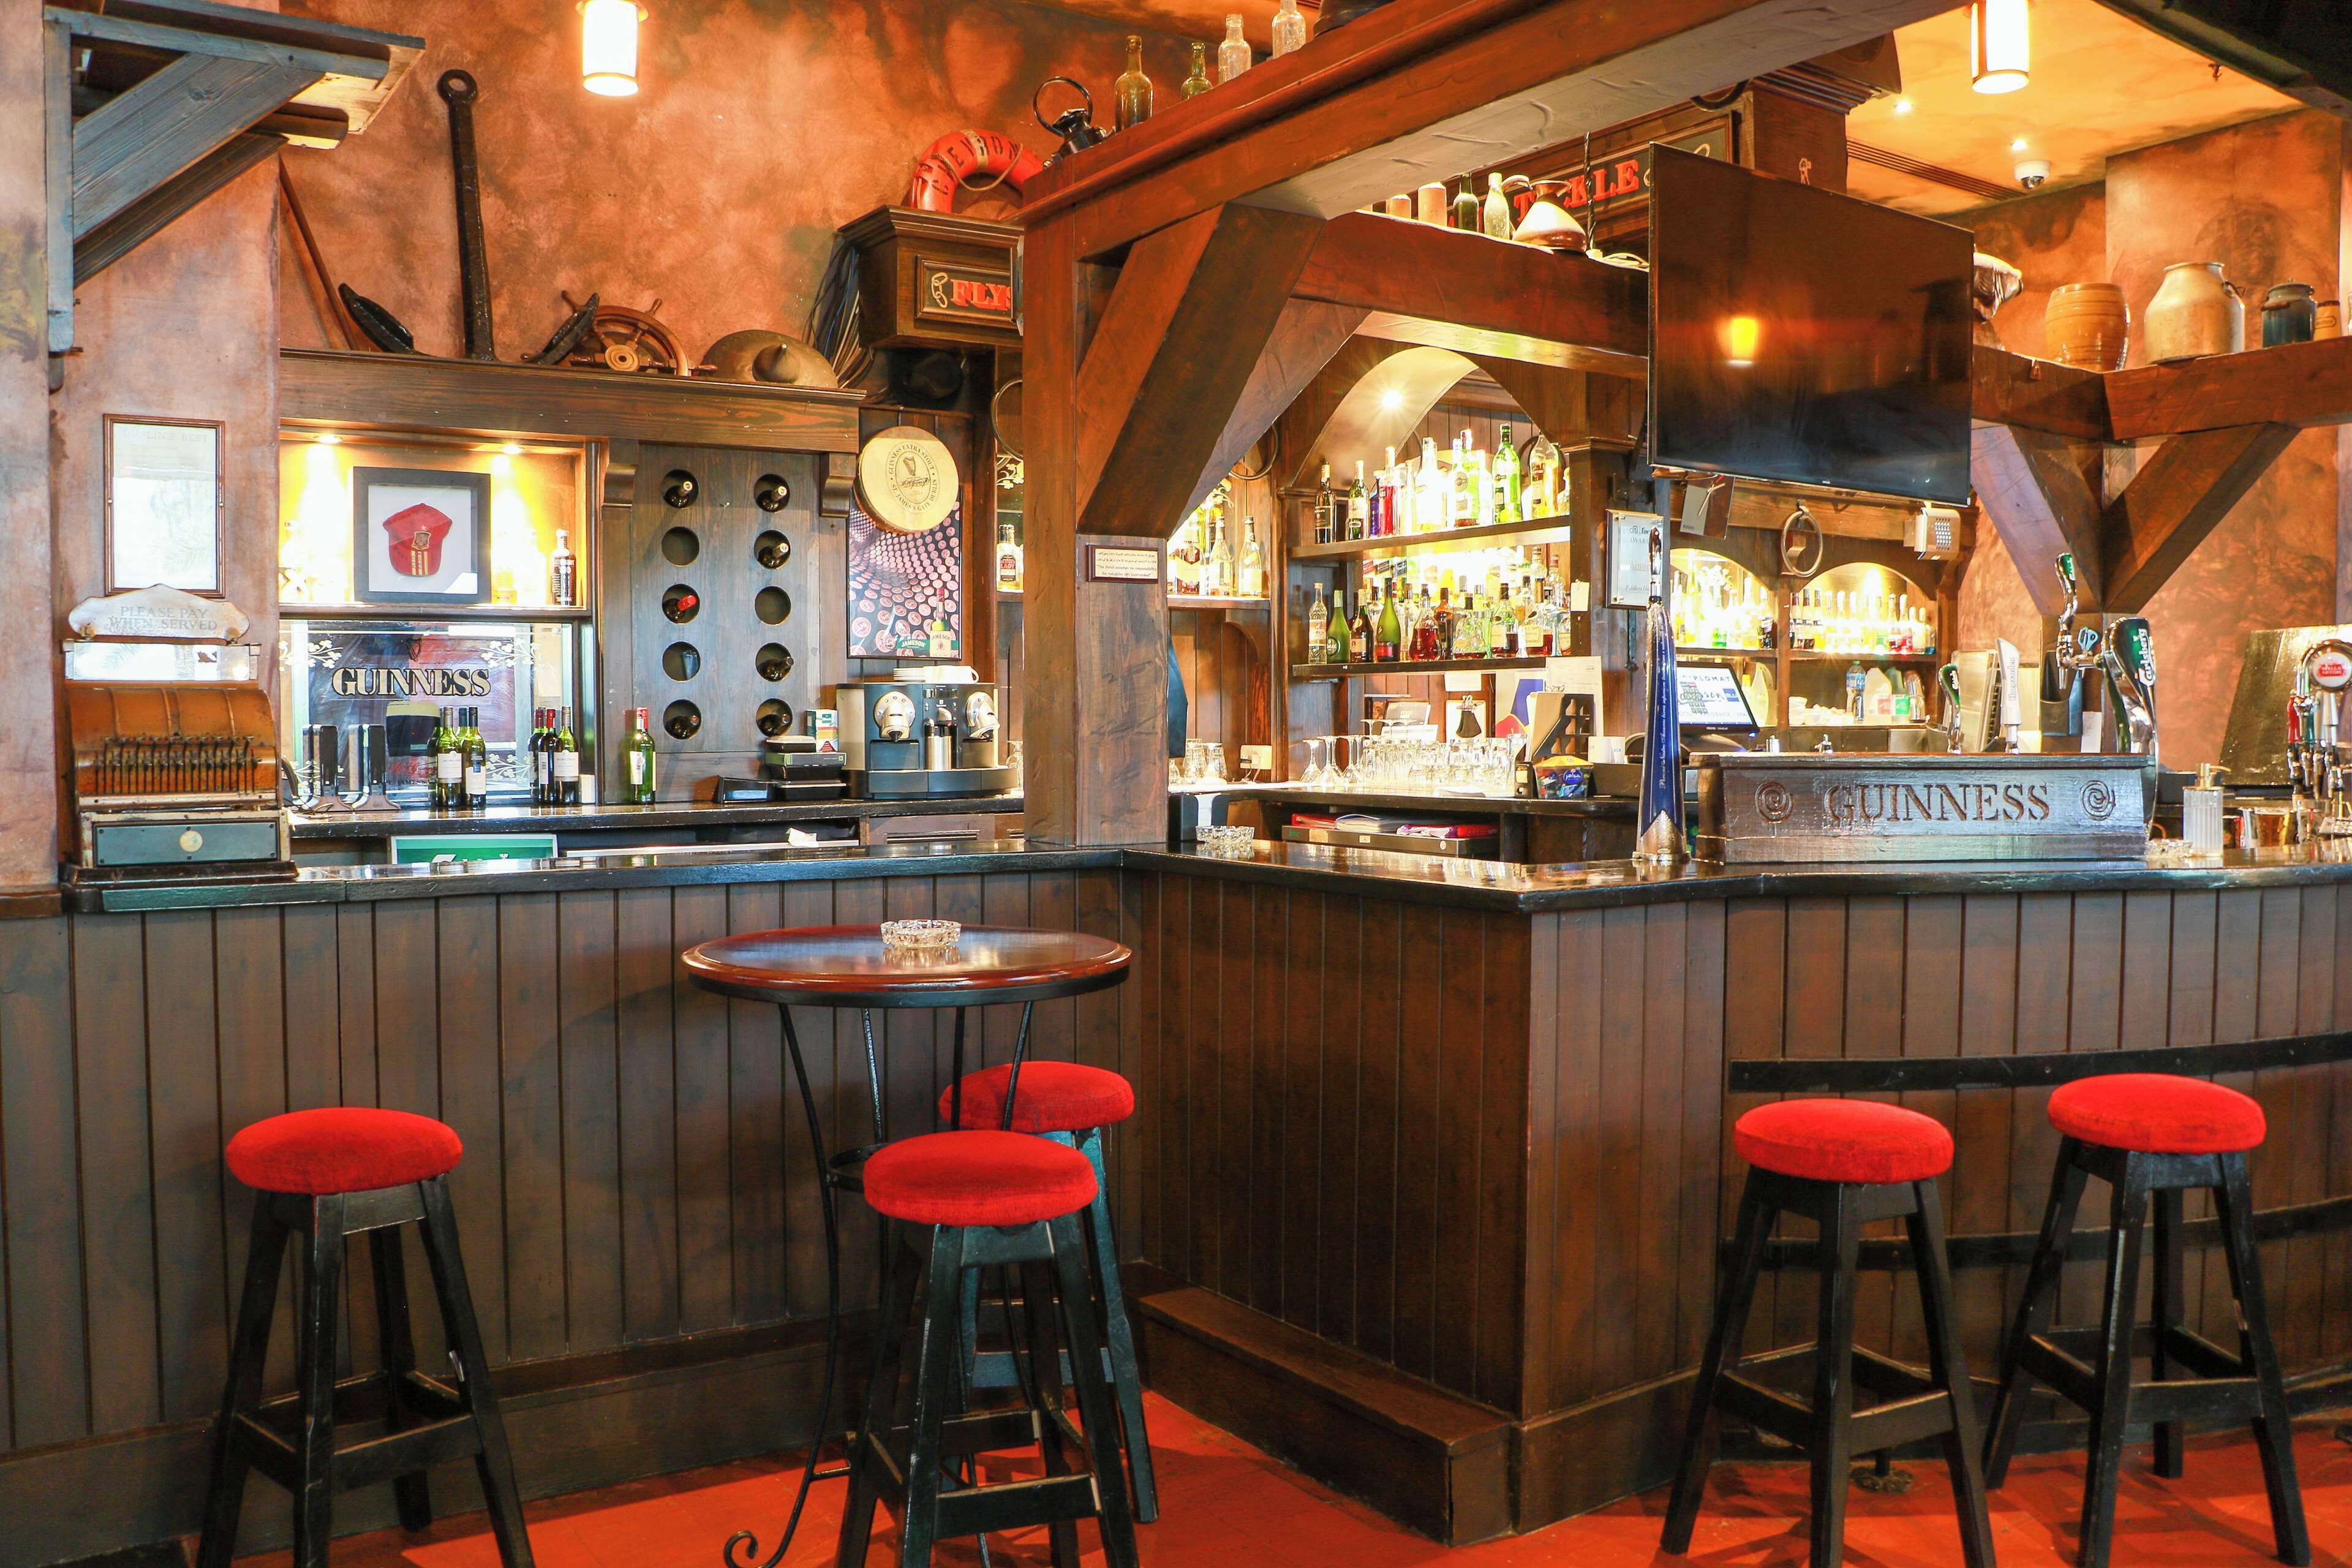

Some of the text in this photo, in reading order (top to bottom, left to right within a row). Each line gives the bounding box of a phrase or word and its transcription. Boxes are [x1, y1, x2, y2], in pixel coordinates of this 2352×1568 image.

[1513, 159, 1639, 224] TKLE
[182, 433, 208, 442] BEST
[921, 451, 935, 470] STOUT
[929, 479, 938, 501] DUBLIN
[1642, 526, 1650, 535] fac
[120, 606, 209, 619] PLEASE PAY
[108, 616, 217, 630] WHEN SERVED
[2138, 628, 2155, 687] Carlsberg
[331, 667, 491, 696] GUINNESS
[1823, 784, 2050, 822] GUINNESS
